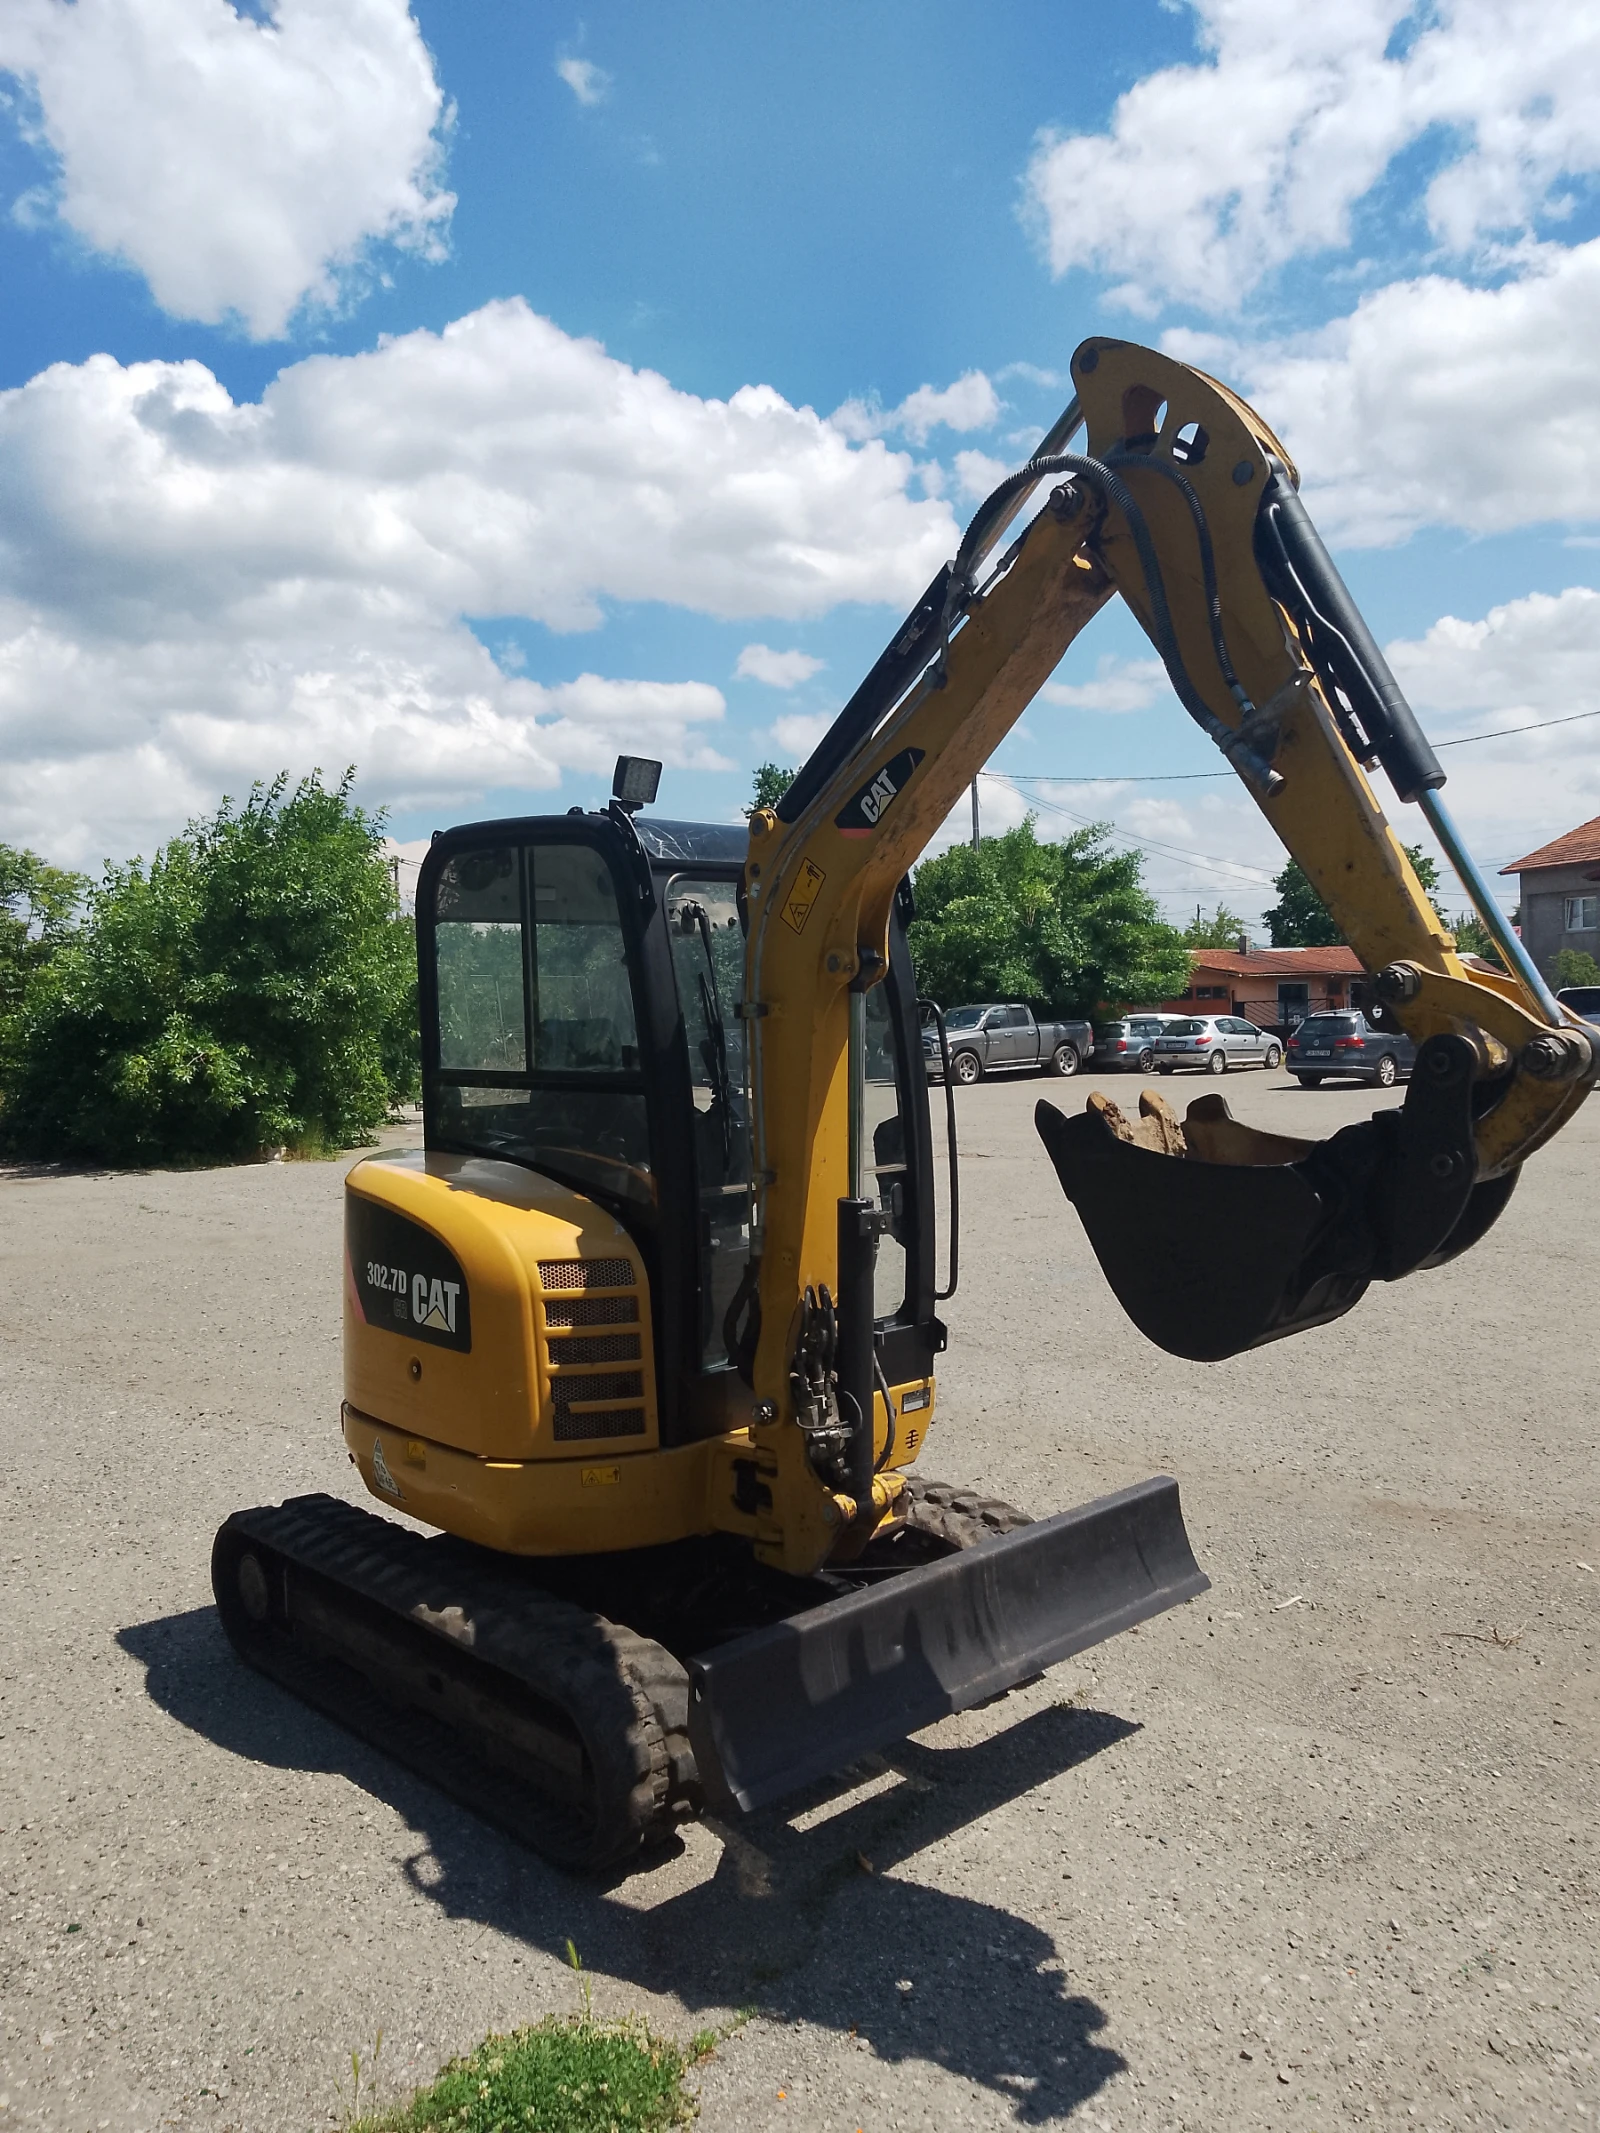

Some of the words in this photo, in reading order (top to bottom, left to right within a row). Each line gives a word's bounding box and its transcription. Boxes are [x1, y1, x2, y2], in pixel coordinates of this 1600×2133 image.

[860, 768, 898, 823] CAT
[367, 1261, 407, 1295] 302.7D
[412, 1273, 460, 1333] CAT
